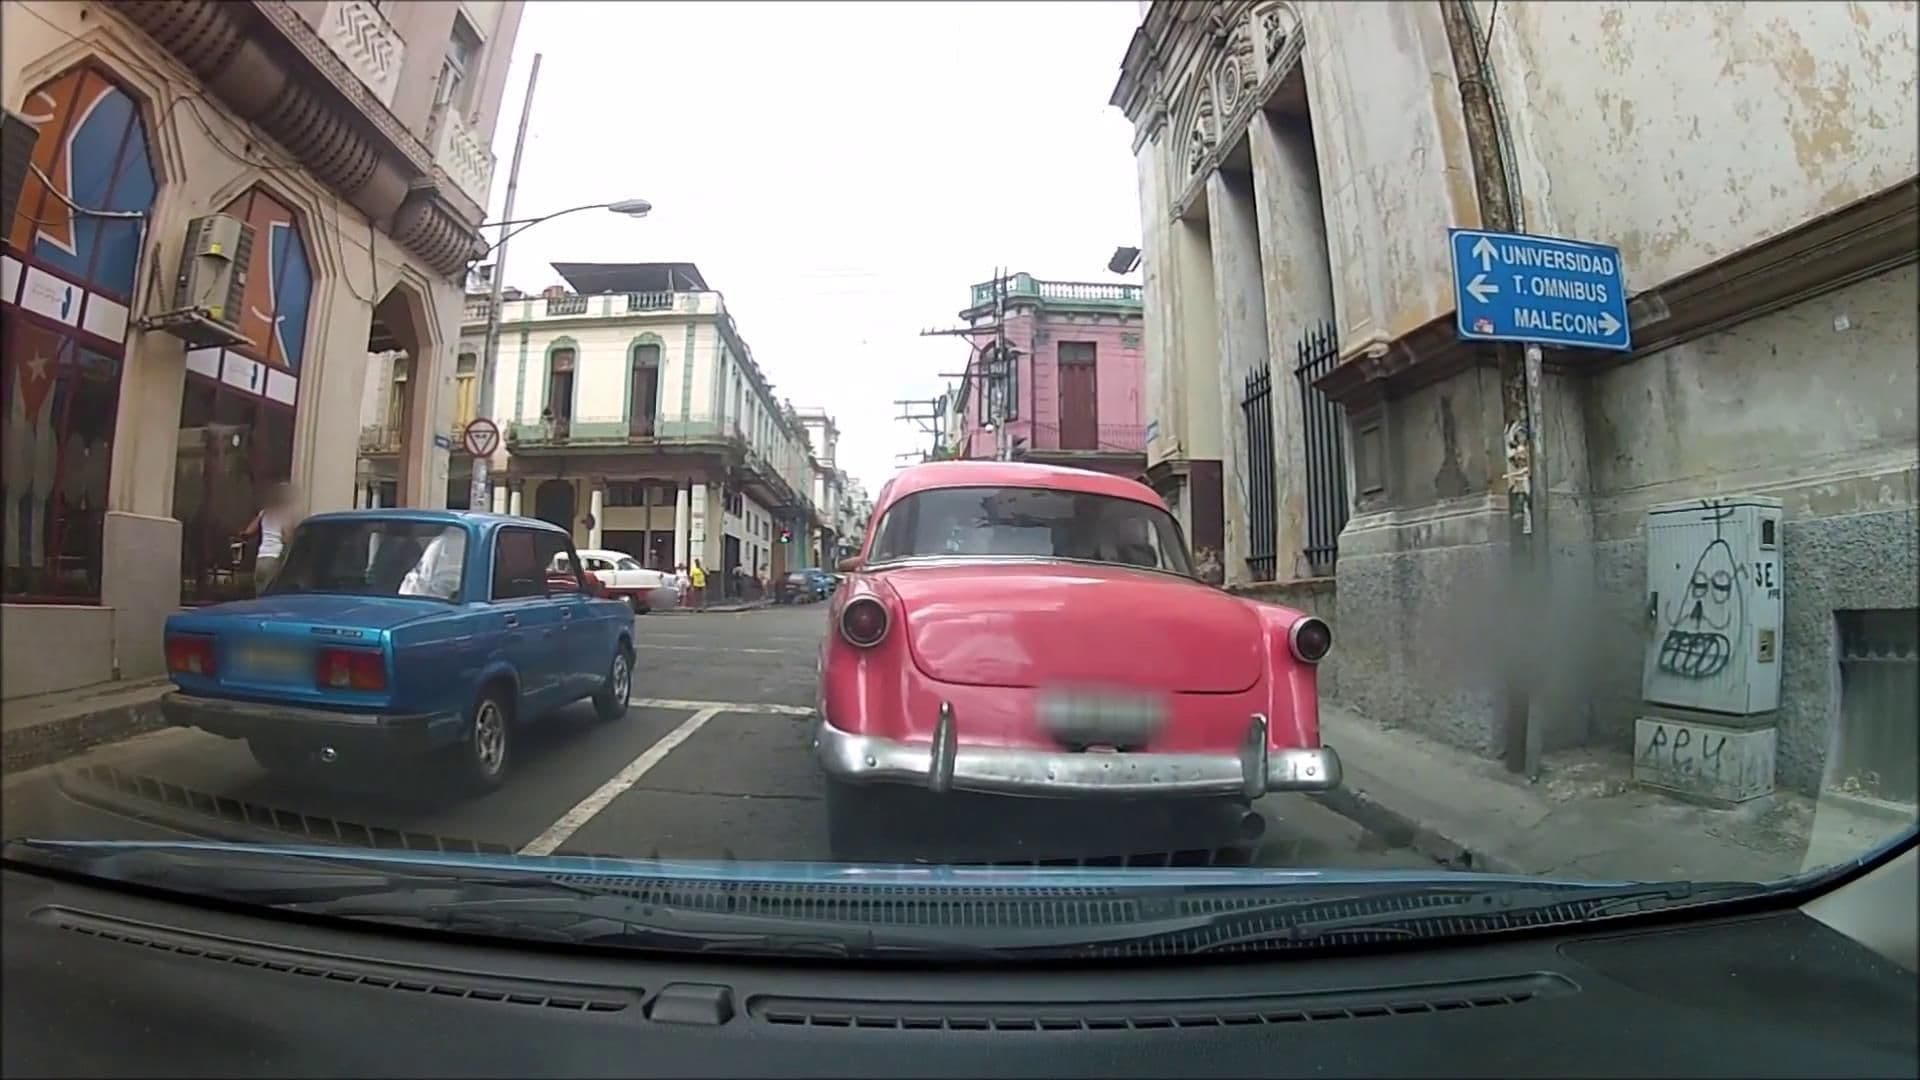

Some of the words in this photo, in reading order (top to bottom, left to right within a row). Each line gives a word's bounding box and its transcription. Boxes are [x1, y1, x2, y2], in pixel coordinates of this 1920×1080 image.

[1502, 245, 1614, 276] UNIVERSIDAD
[1514, 275, 1528, 294] T.
[1531, 277, 1607, 303] OMNIBUS
[1515, 308, 1598, 334] MALECON
